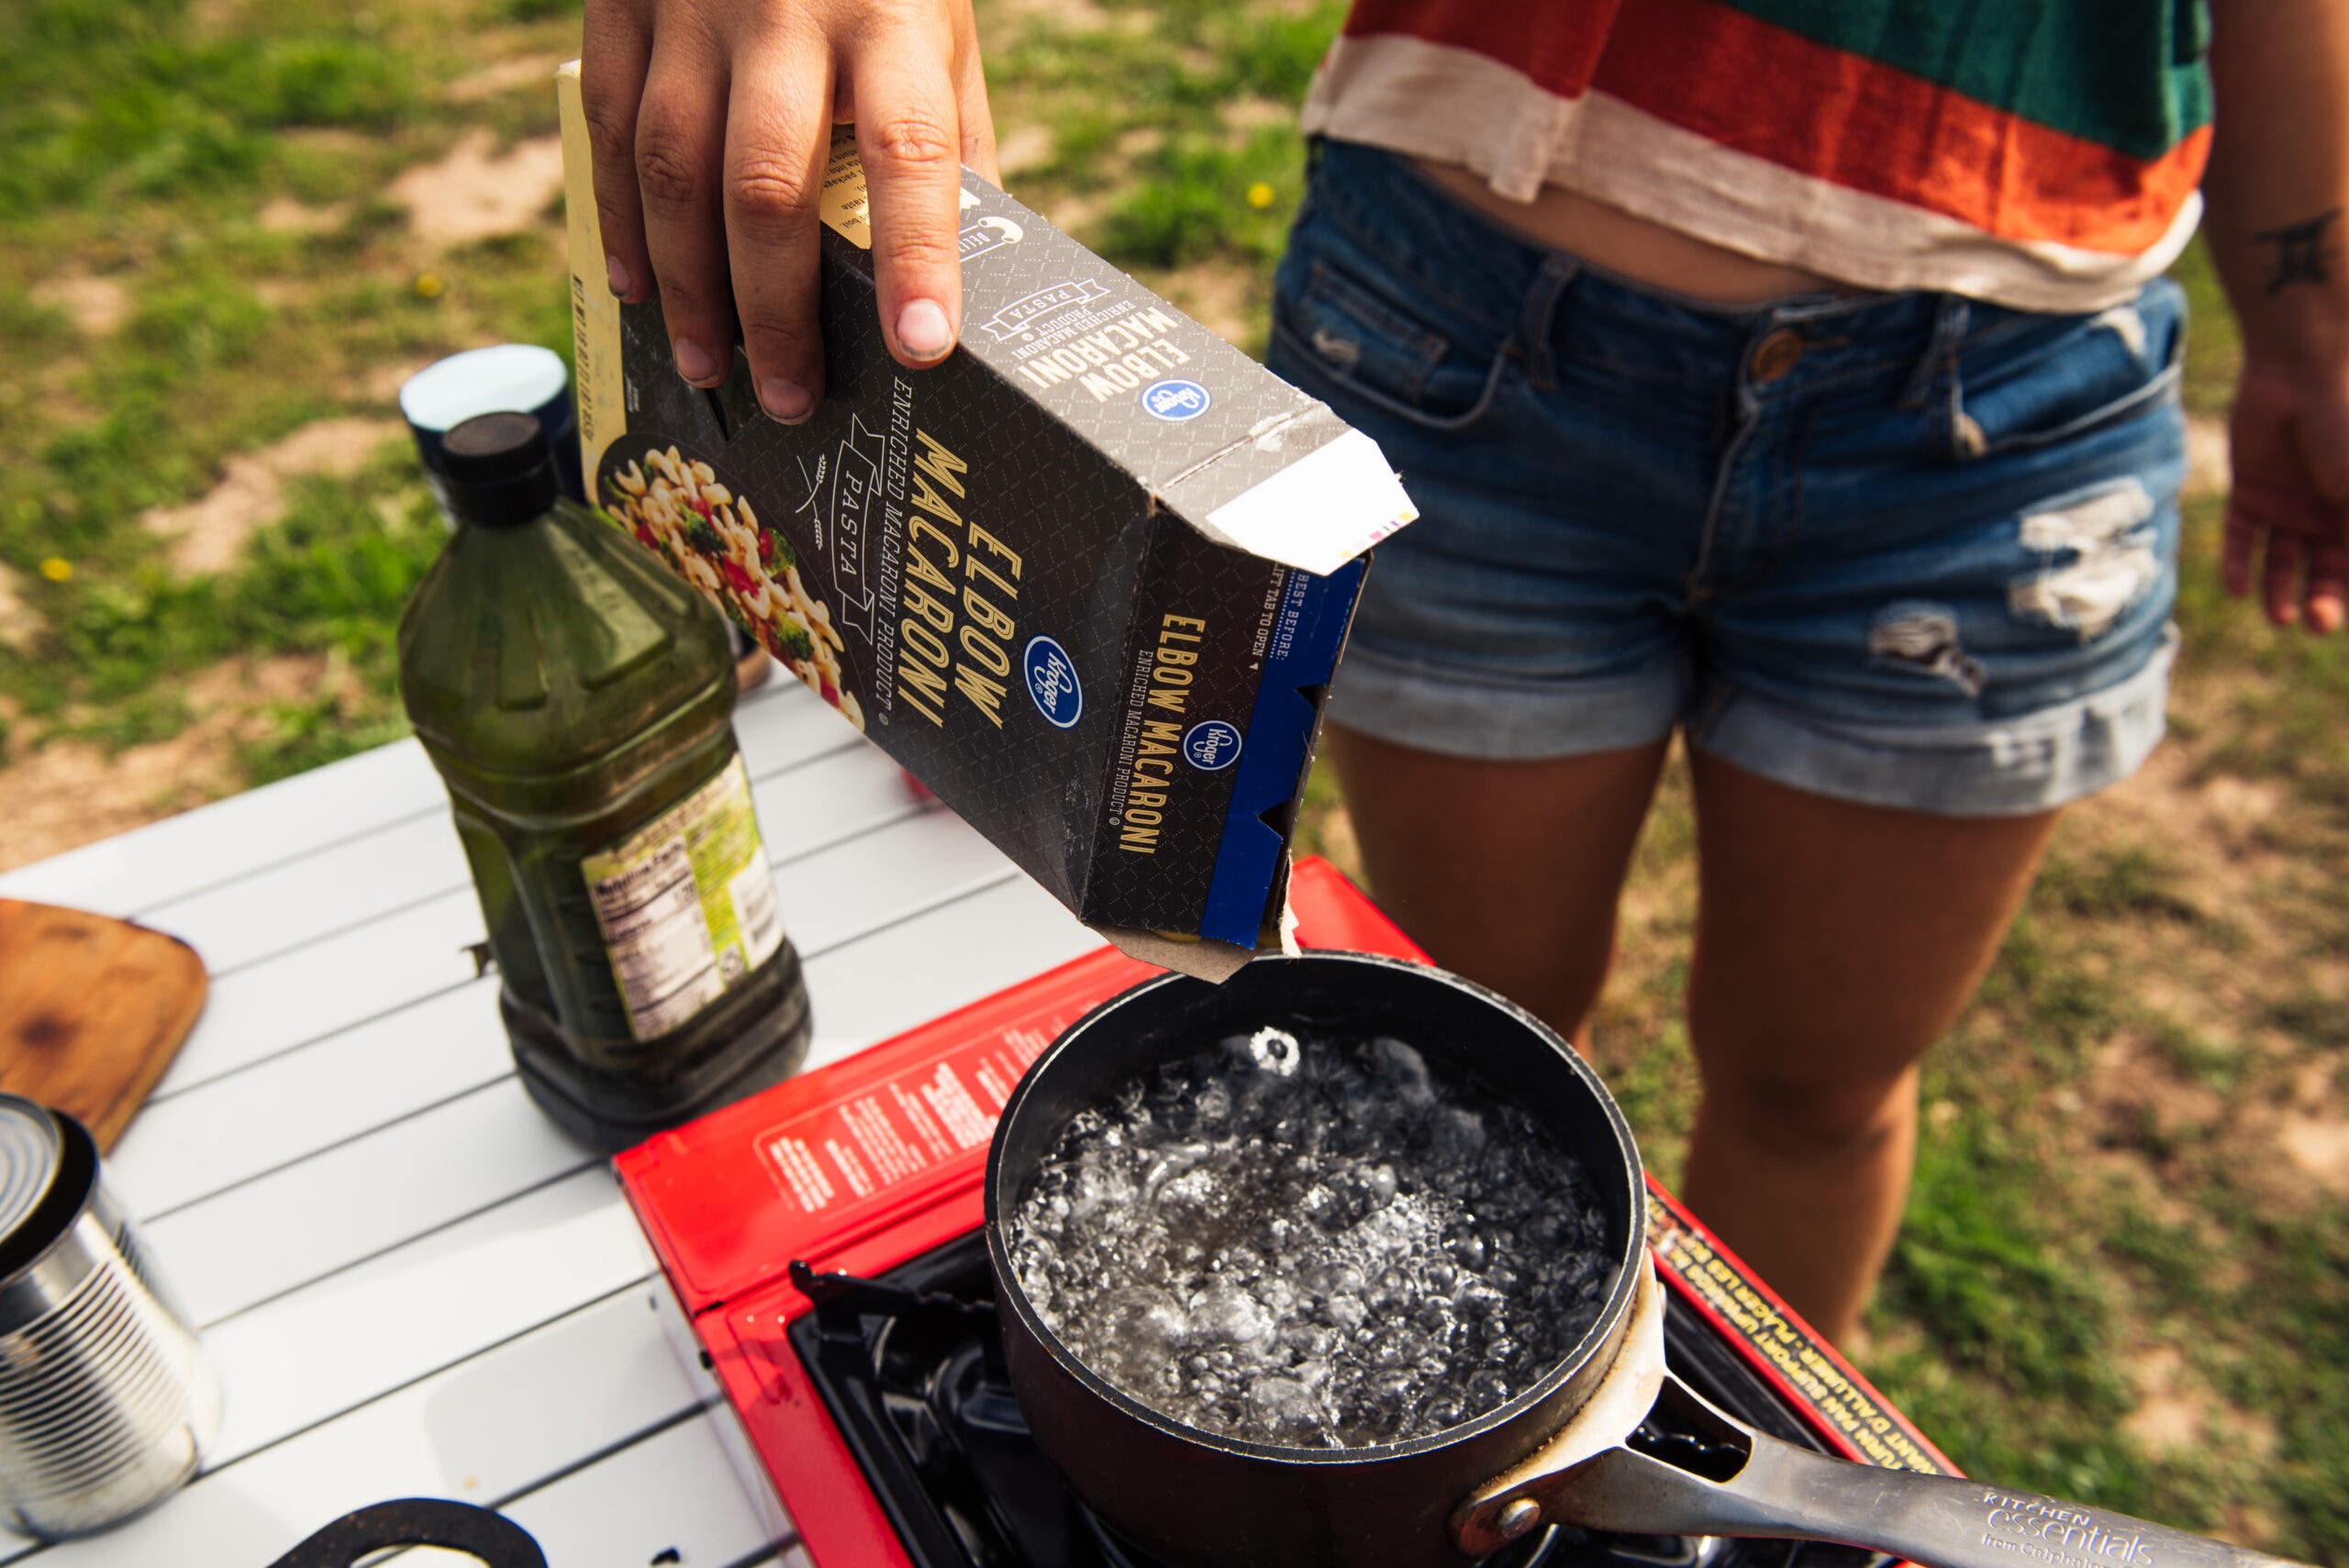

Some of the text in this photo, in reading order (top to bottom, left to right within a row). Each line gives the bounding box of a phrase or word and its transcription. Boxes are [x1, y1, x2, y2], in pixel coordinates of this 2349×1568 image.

[1008, 290, 1071, 320] PASTA
[1011, 299, 1136, 360] ENRICHED MACARONI
[1034, 306, 1093, 335] PRODUCT
[1018, 306, 1178, 389] MACARONI
[1079, 339, 1190, 403] ELBOW
[841, 470, 863, 576] PASTA
[874, 376, 911, 711] ENRICHED MACARONI PRODUCT
[897, 428, 968, 728] MACARONI
[1264, 589, 1279, 610] TAB
[954, 521, 1022, 729] ELBOW
[1252, 628, 1269, 657] OPEN
[1260, 612, 1274, 627] TO
[1276, 574, 1309, 661] BEST BEFORE:
[1034, 651, 1072, 715] Kroger
[1109, 650, 1153, 815] ENRICHED MACARONI PRODUCT
[1119, 614, 1206, 854] ELBOW MACARONI
[1193, 728, 1228, 764] Kroger
[1733, 1285, 1798, 1345] PLACER
[1753, 1331, 1828, 1400] SUPPORT
[1821, 1396, 1860, 1432] PAN
[1854, 1428, 1903, 1470] TURN
[1983, 1491, 2091, 1526] KITCHEN
[1981, 1533, 2017, 1551] from
